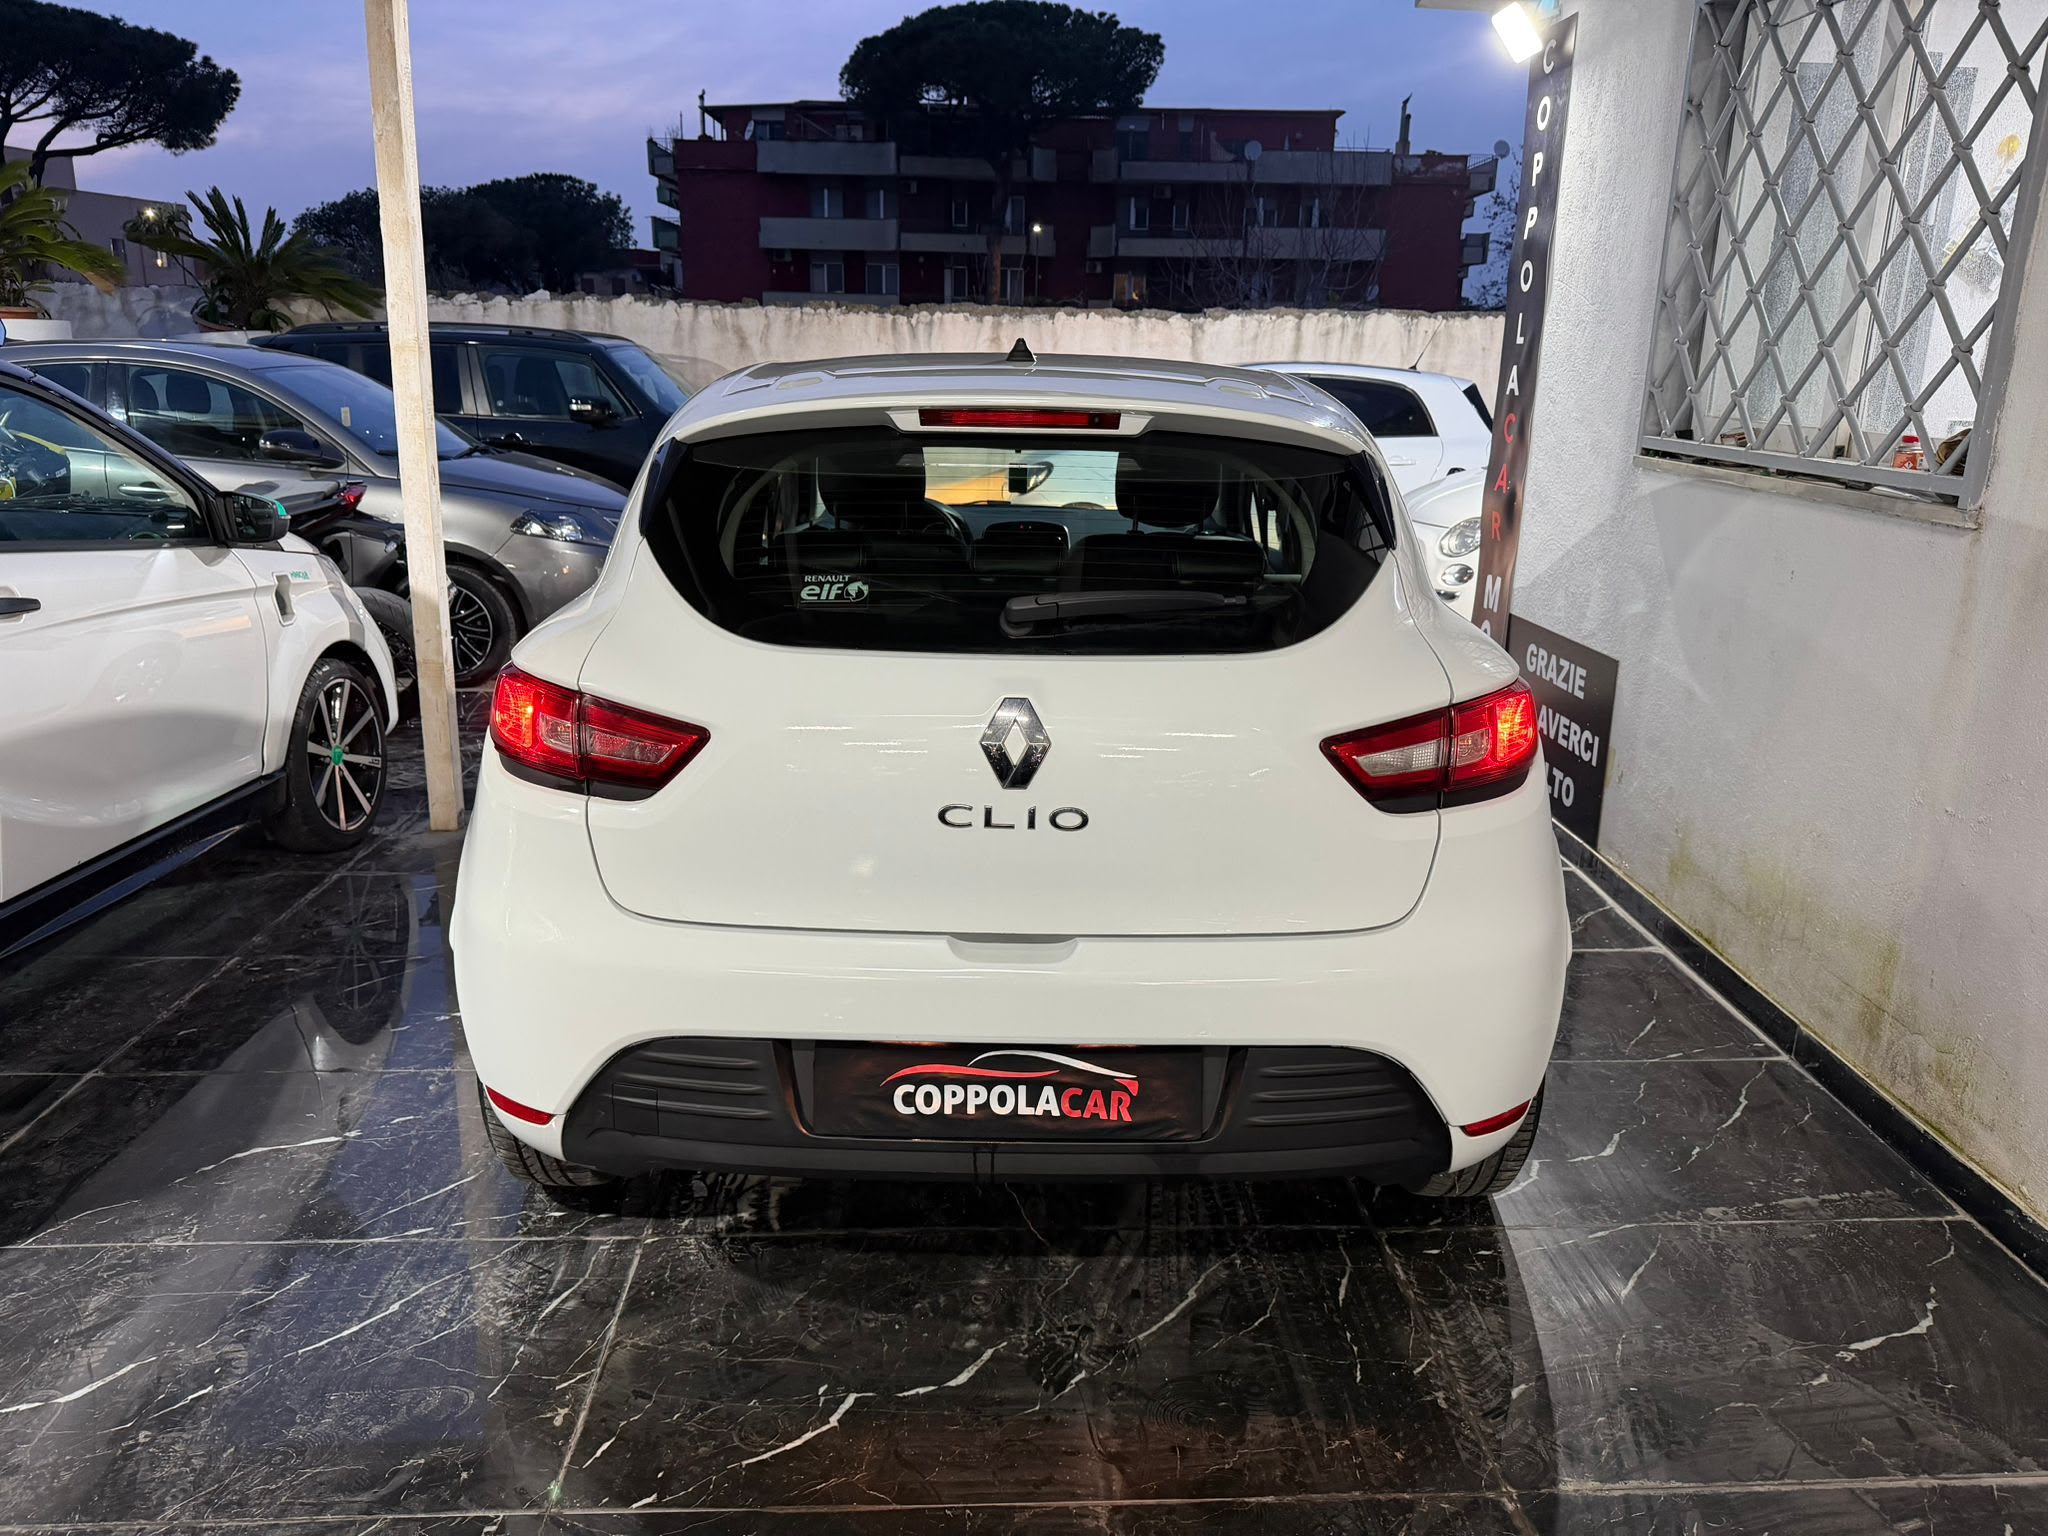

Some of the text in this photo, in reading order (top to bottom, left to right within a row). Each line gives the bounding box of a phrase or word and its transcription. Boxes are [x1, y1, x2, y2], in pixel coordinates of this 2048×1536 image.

[800, 583, 845, 600] elf
[804, 574, 851, 583] RENAULT
[1526, 643, 1587, 700] GRAZIE
[1538, 704, 1600, 768] AVERCI
[937, 803, 1090, 832] CLIO
